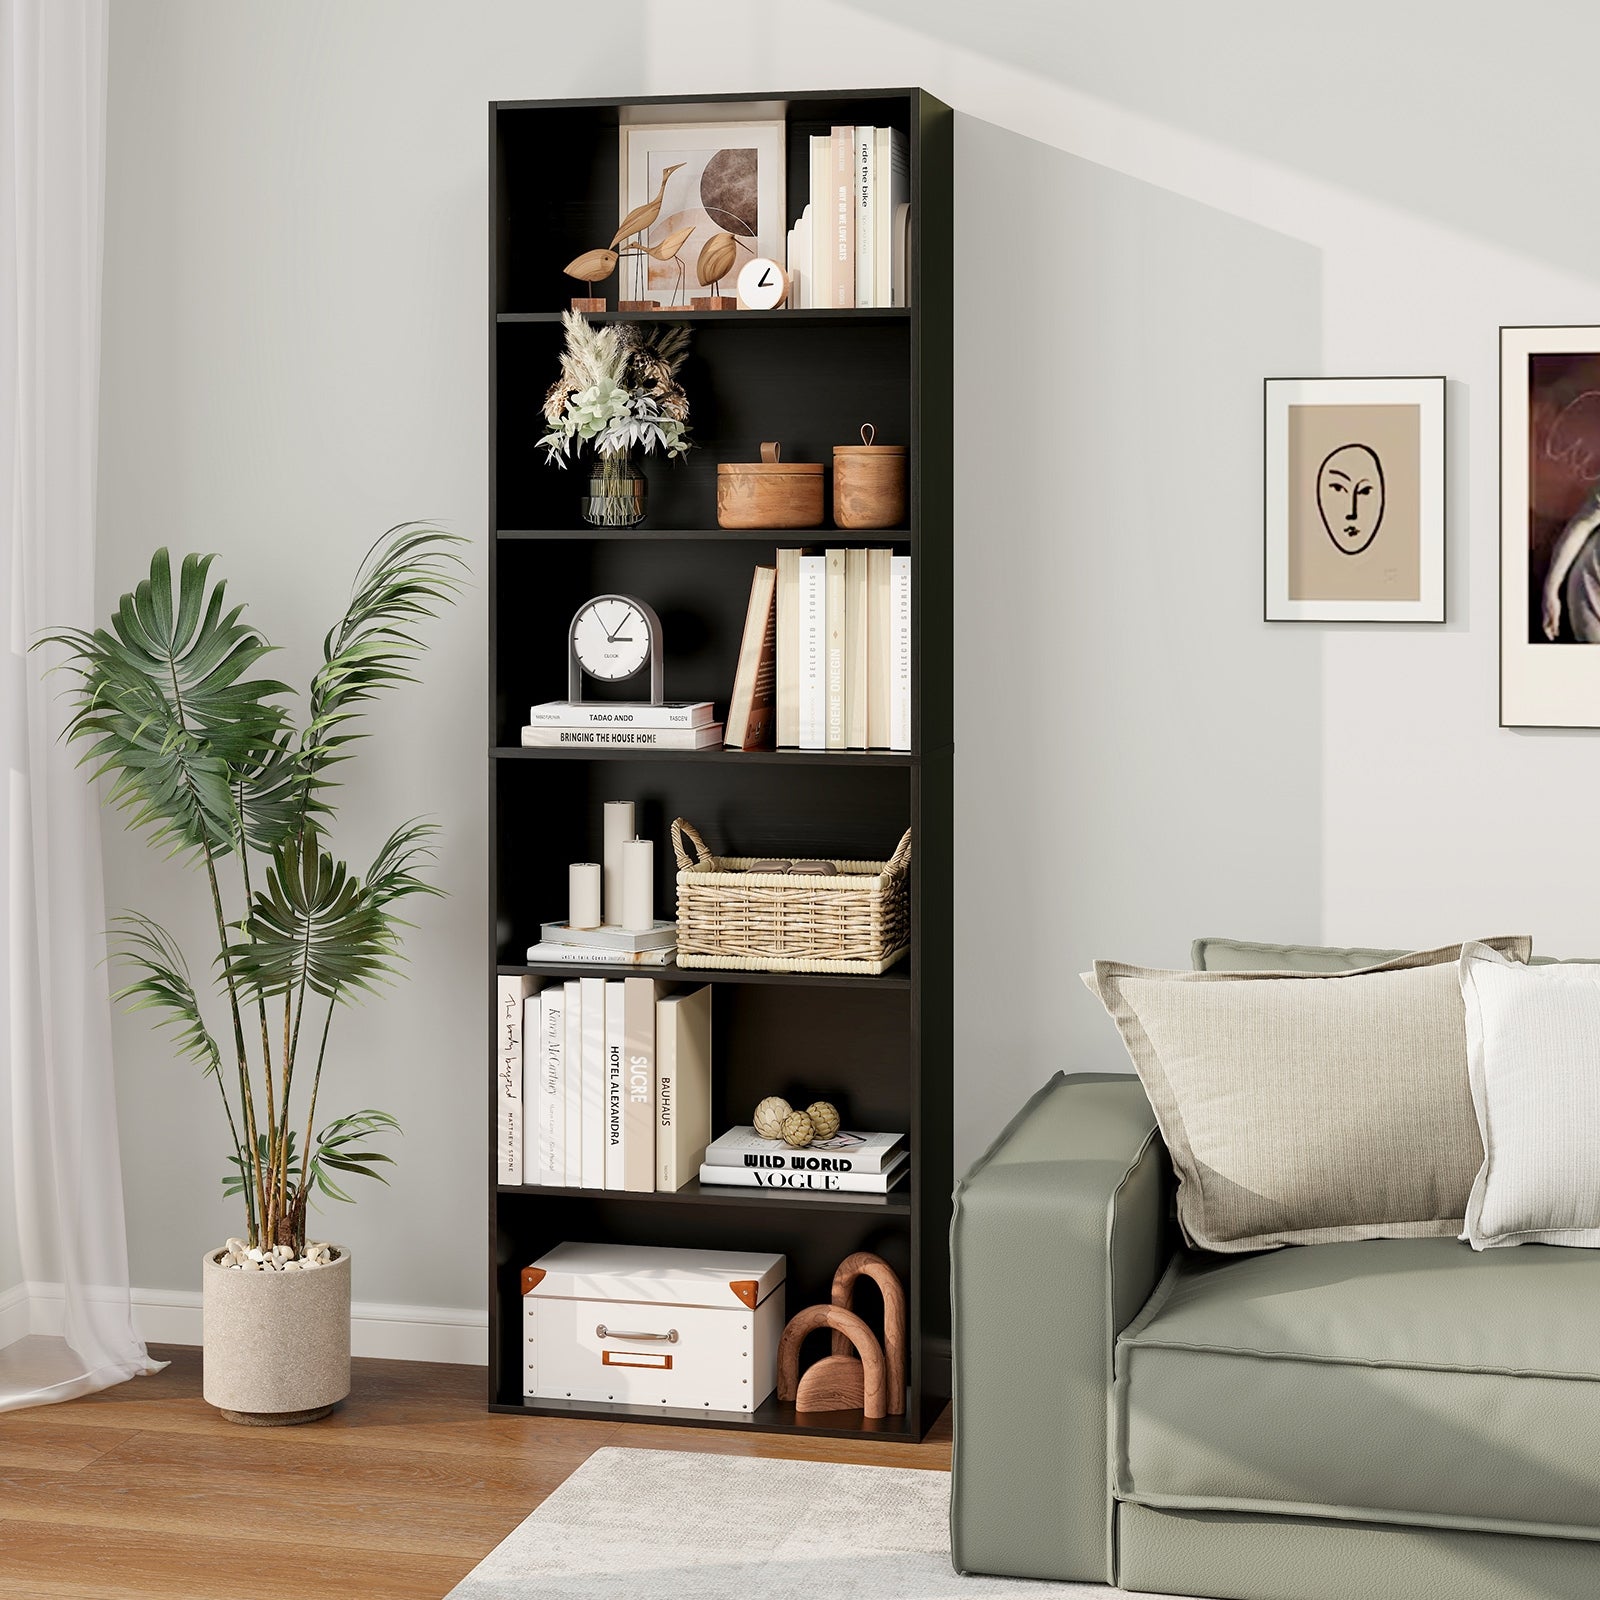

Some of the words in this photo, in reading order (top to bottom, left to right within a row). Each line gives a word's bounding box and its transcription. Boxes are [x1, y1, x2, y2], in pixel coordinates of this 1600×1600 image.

[861, 143, 869, 164] ride
[861, 166, 869, 183] the
[838, 185, 847, 202] WHY
[861, 185, 869, 208] bike
[838, 202, 847, 213] DO
[838, 214, 847, 226] WE
[838, 226, 847, 242] LOVE
[838, 243, 847, 261] CATS
[900, 575, 908, 620] STORIES
[900, 627, 908, 679] SELECTED
[831, 648, 841, 692] ONEGIN
[589, 714, 613, 722] TADAO
[614, 714, 634, 722] ANDO
[831, 694, 841, 742] EUGENE
[560, 732, 595, 743] BRINGING
[596, 733, 610, 743] THE
[611, 733, 635, 743] HOUSE
[636, 733, 657, 744] HOME
[504, 993, 517, 1020] The
[548, 1008, 561, 1038] Karen
[503, 1023, 520, 1052] body
[610, 1045, 620, 1081] HOTEL
[499, 1056, 518, 1100] beyond
[630, 1055, 649, 1103] SUCRE
[610, 1082, 620, 1146] ALEXANDRA
[661, 1077, 671, 1127] BAUHAUS
[743, 1153, 786, 1168] WILD
[791, 1156, 853, 1172] WORLD
[753, 1171, 840, 1190] VOGUE
